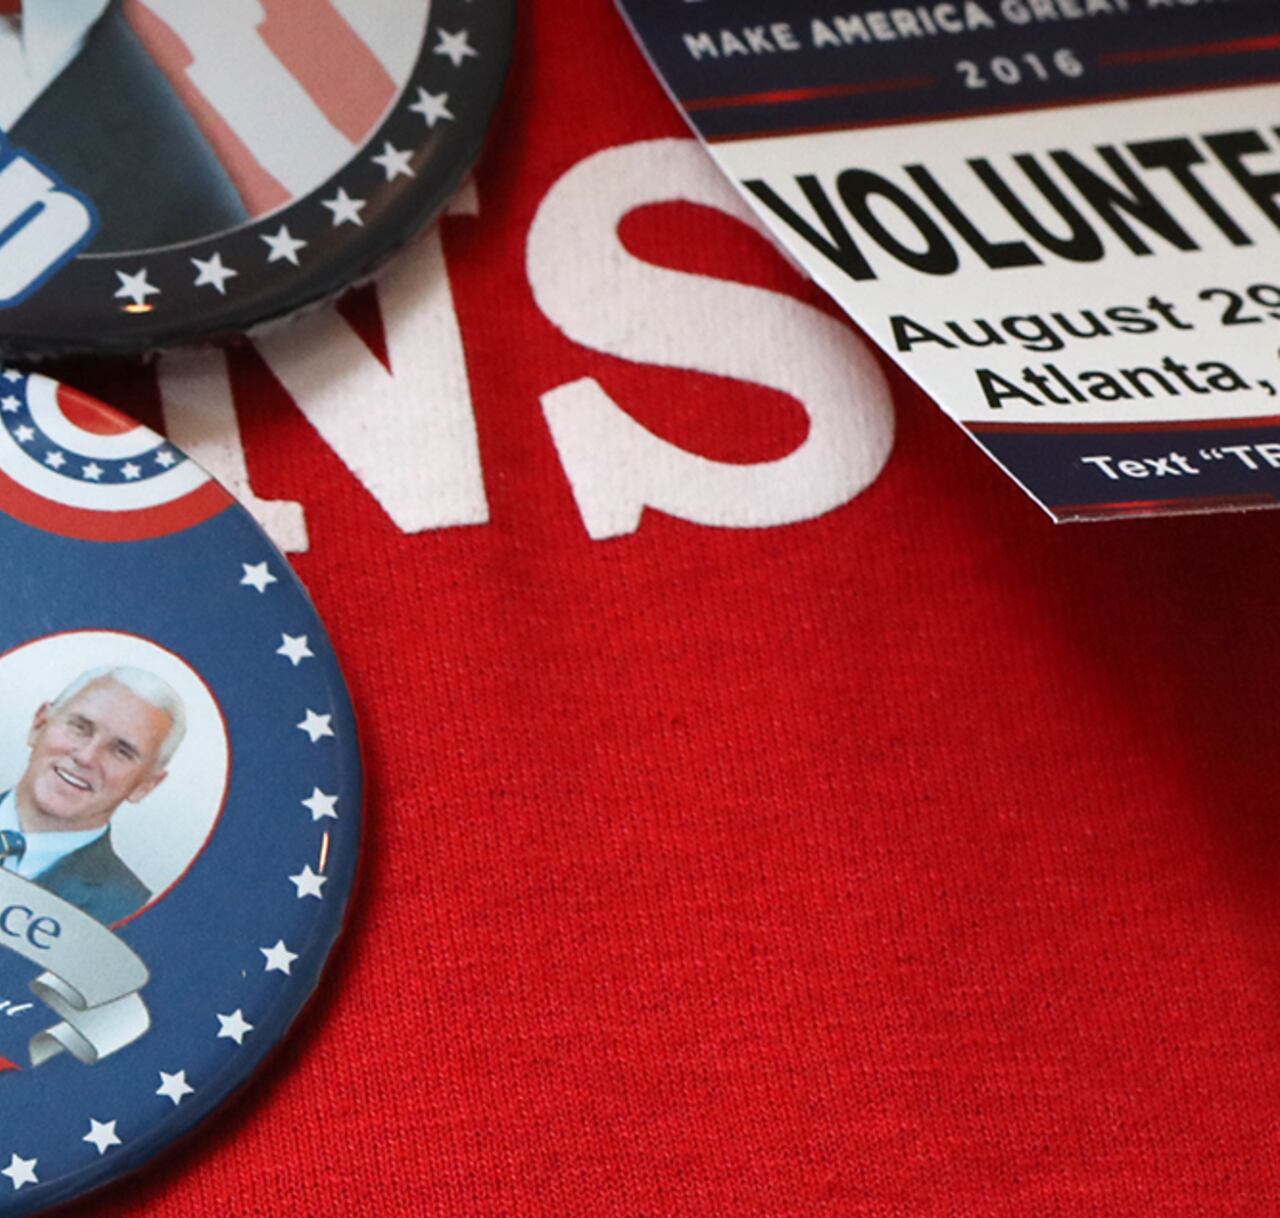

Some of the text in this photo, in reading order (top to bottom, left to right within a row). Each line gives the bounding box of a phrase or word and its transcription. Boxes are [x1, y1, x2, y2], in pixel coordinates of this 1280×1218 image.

[681, 25, 801, 61] MAKE
[810, 9, 996, 50] AMERICA
[956, 48, 1085, 89] 2016
[889, 294, 1195, 352] August
[974, 355, 1278, 409] Atlanta,
[1081, 451, 1201, 481] Text
